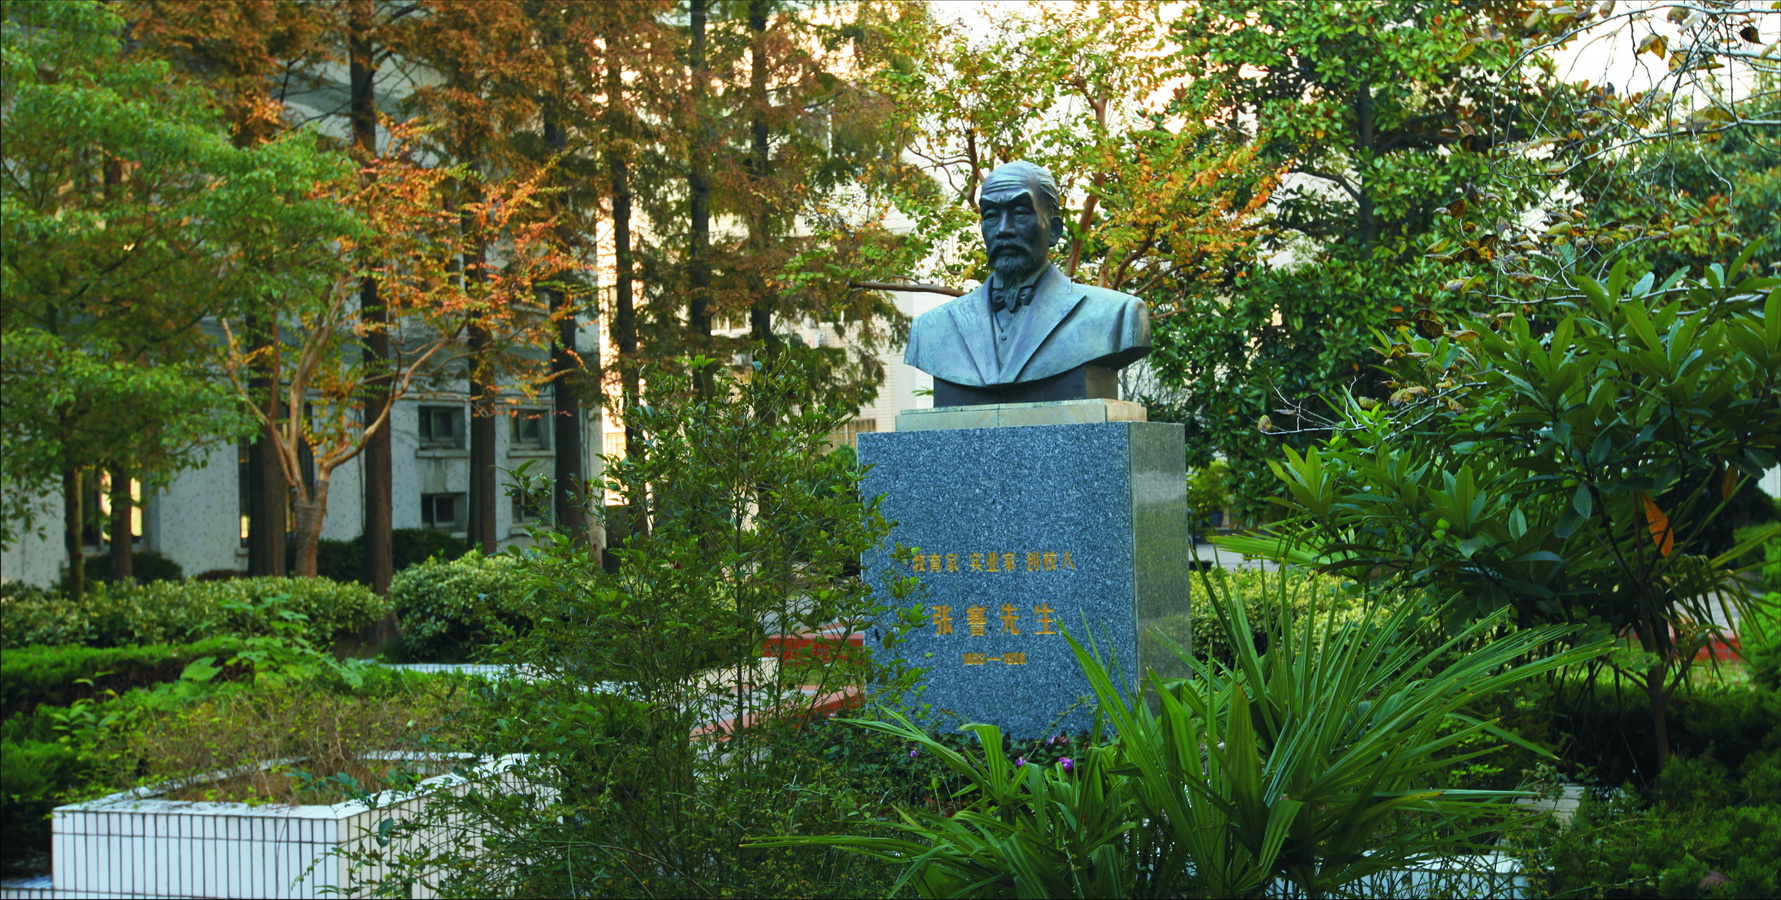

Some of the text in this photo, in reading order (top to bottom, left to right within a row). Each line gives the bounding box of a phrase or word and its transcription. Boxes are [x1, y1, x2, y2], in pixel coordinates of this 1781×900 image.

[912, 550, 1076, 573] 教育家 实业家 创校人
[932, 602, 1056, 636] 张謇先生
